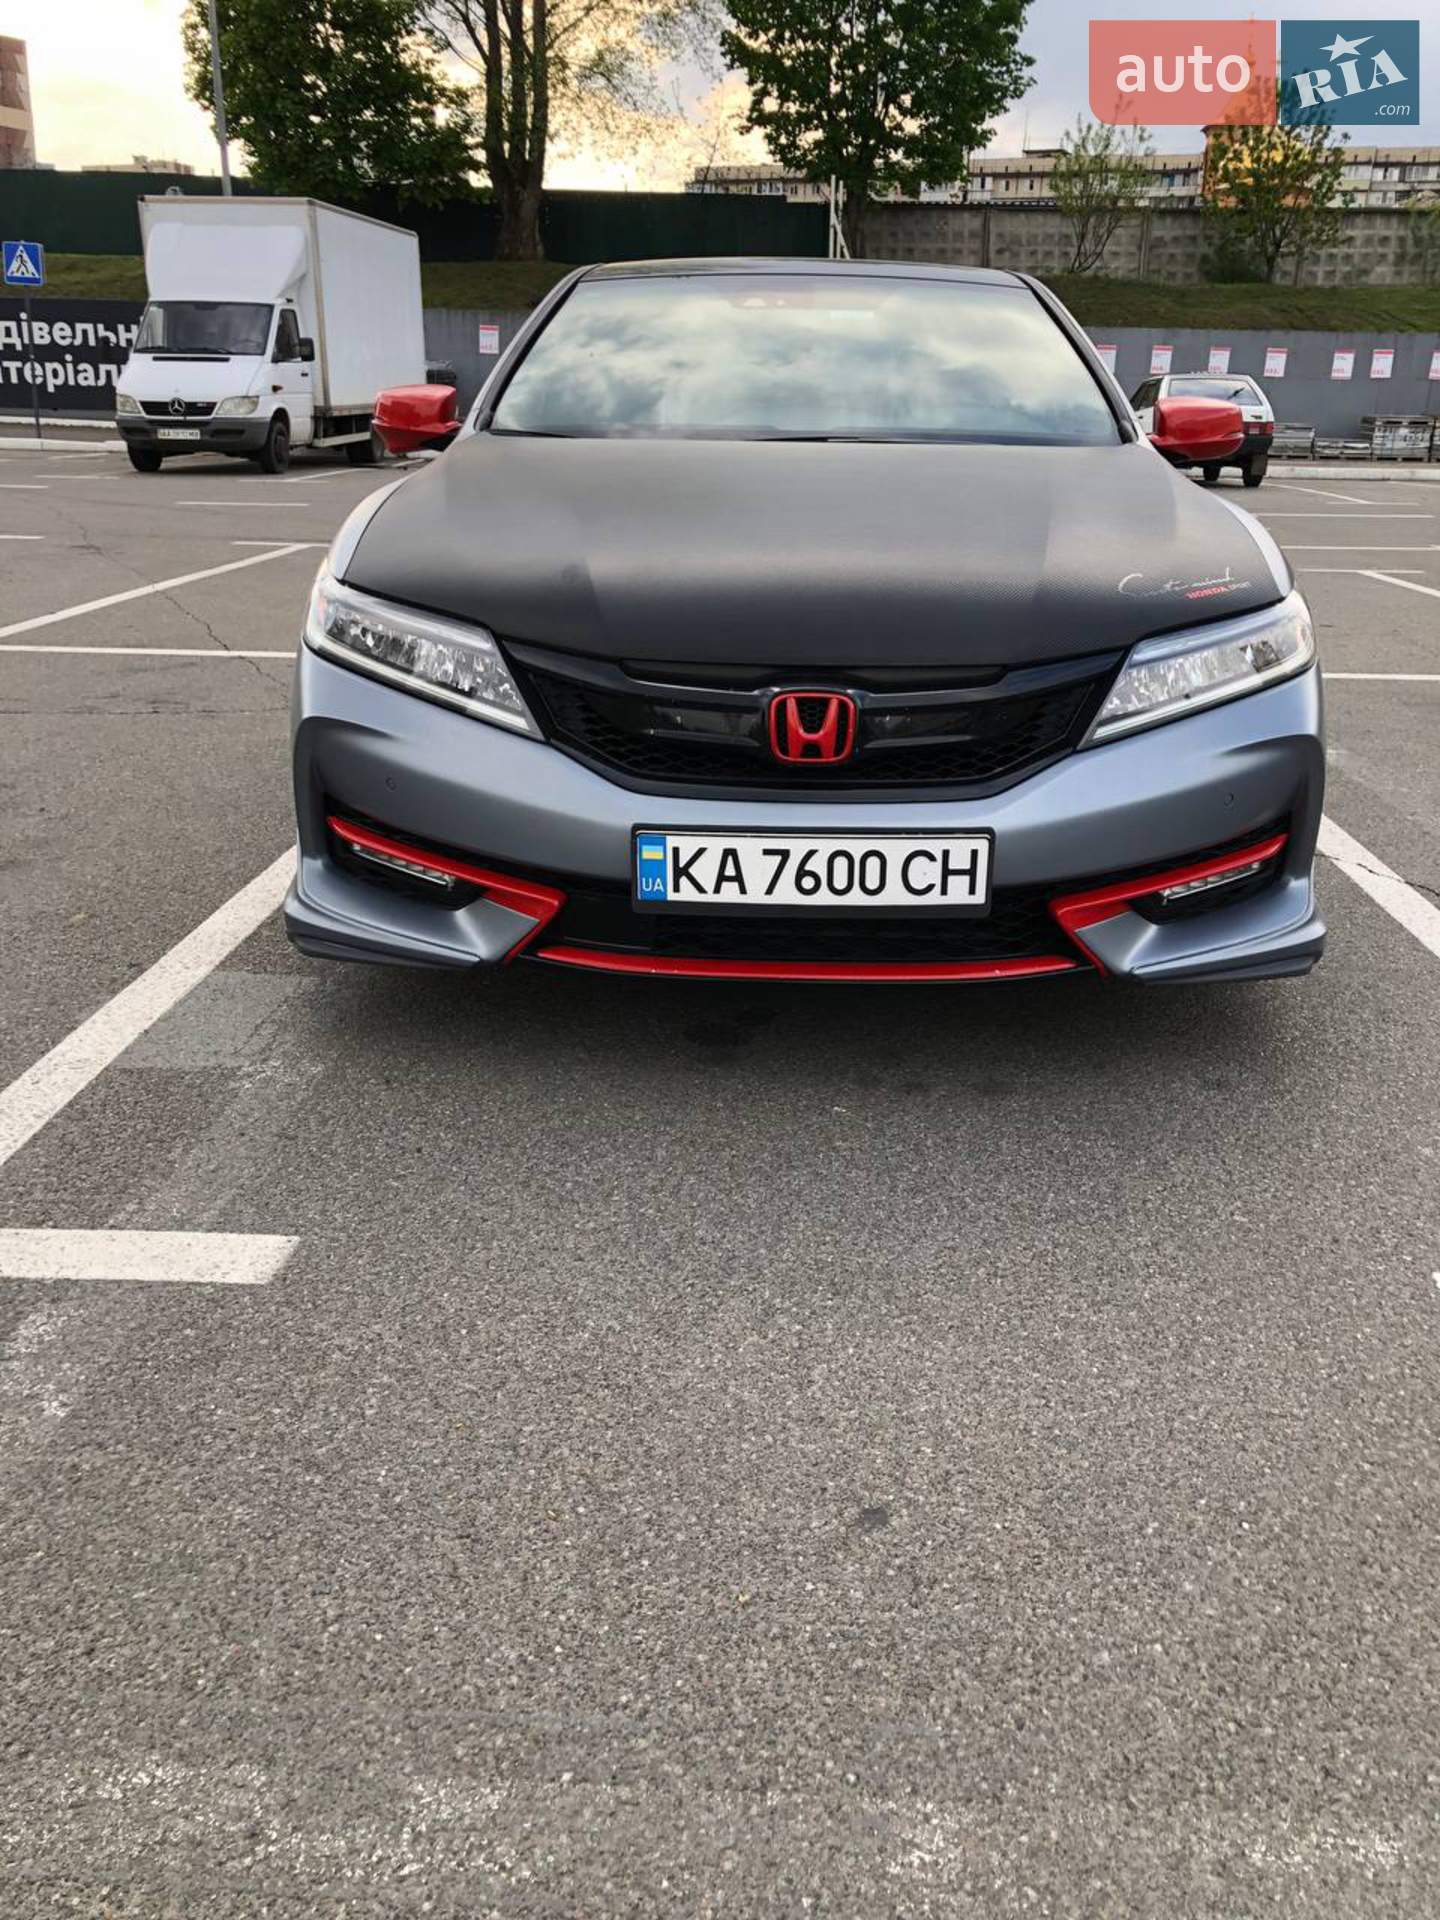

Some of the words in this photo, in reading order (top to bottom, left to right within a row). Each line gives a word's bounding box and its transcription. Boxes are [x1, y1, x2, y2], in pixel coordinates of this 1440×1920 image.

[0, 312, 143, 350] дівельн
[0, 353, 126, 393] теріал
[642, 877, 664, 893] UA
[671, 846, 748, 895] KA
[762, 848, 887, 897] 7600
[901, 848, 977, 897] CH
